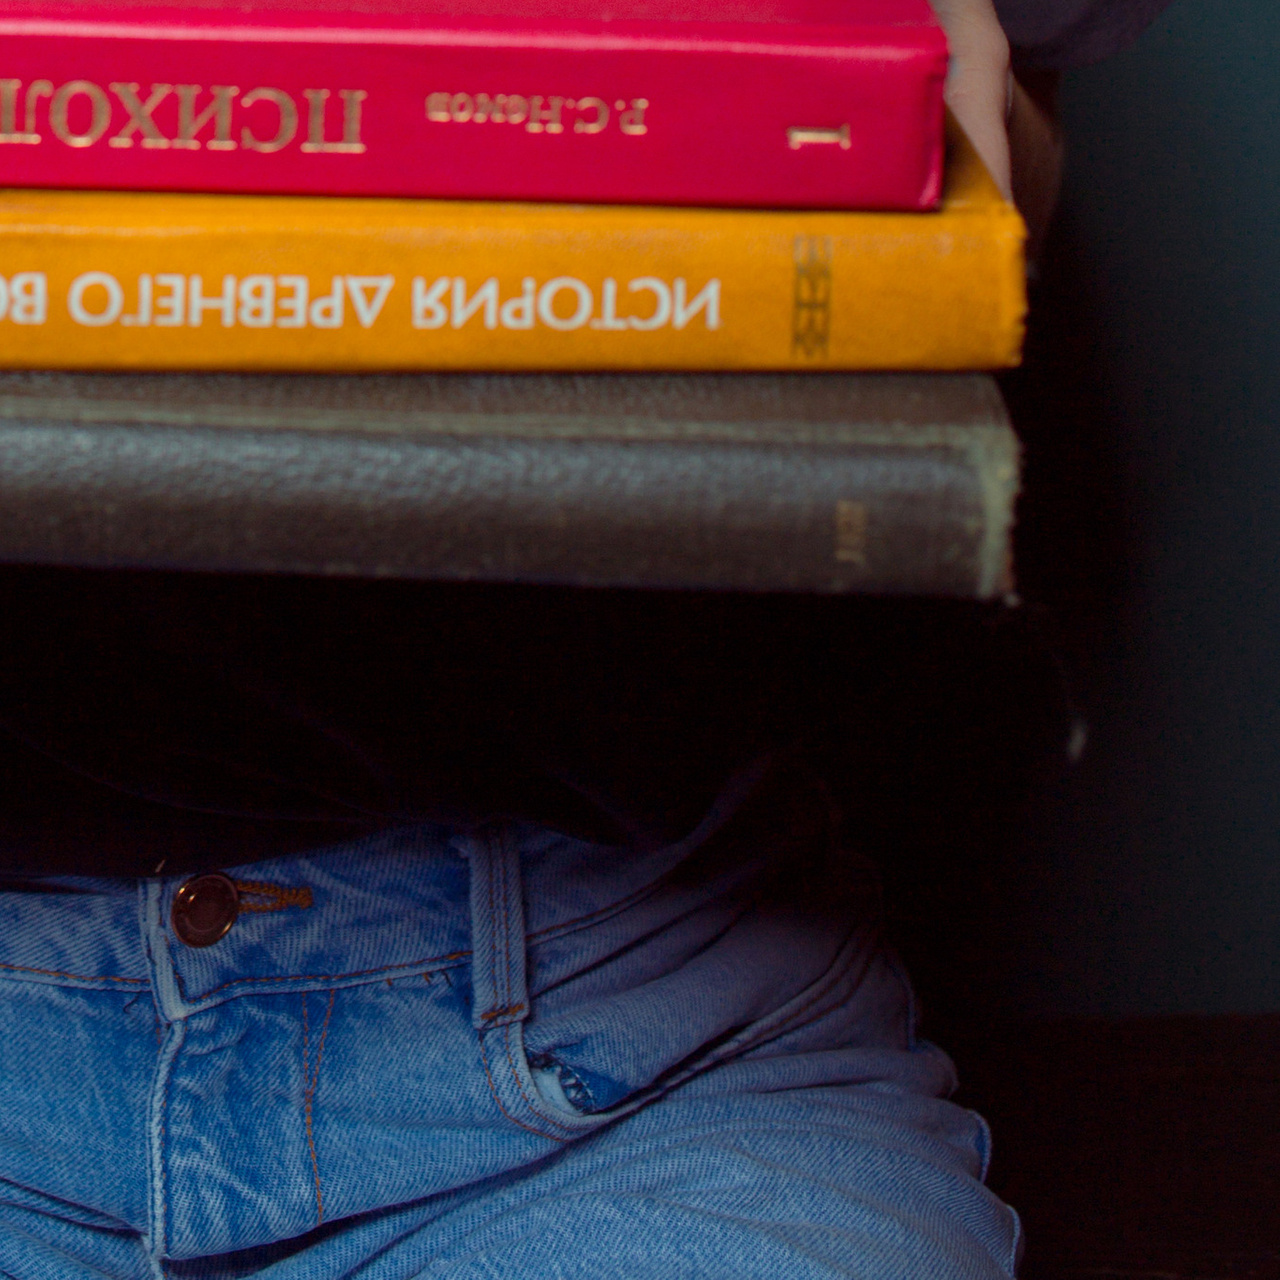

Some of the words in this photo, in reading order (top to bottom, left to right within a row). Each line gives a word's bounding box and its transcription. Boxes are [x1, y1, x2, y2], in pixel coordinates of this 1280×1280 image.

[788, 126, 853, 151] 1
[68, 273, 395, 328] ДРЕВНЕГО
[411, 277, 723, 330] ИСТОРИЯ
